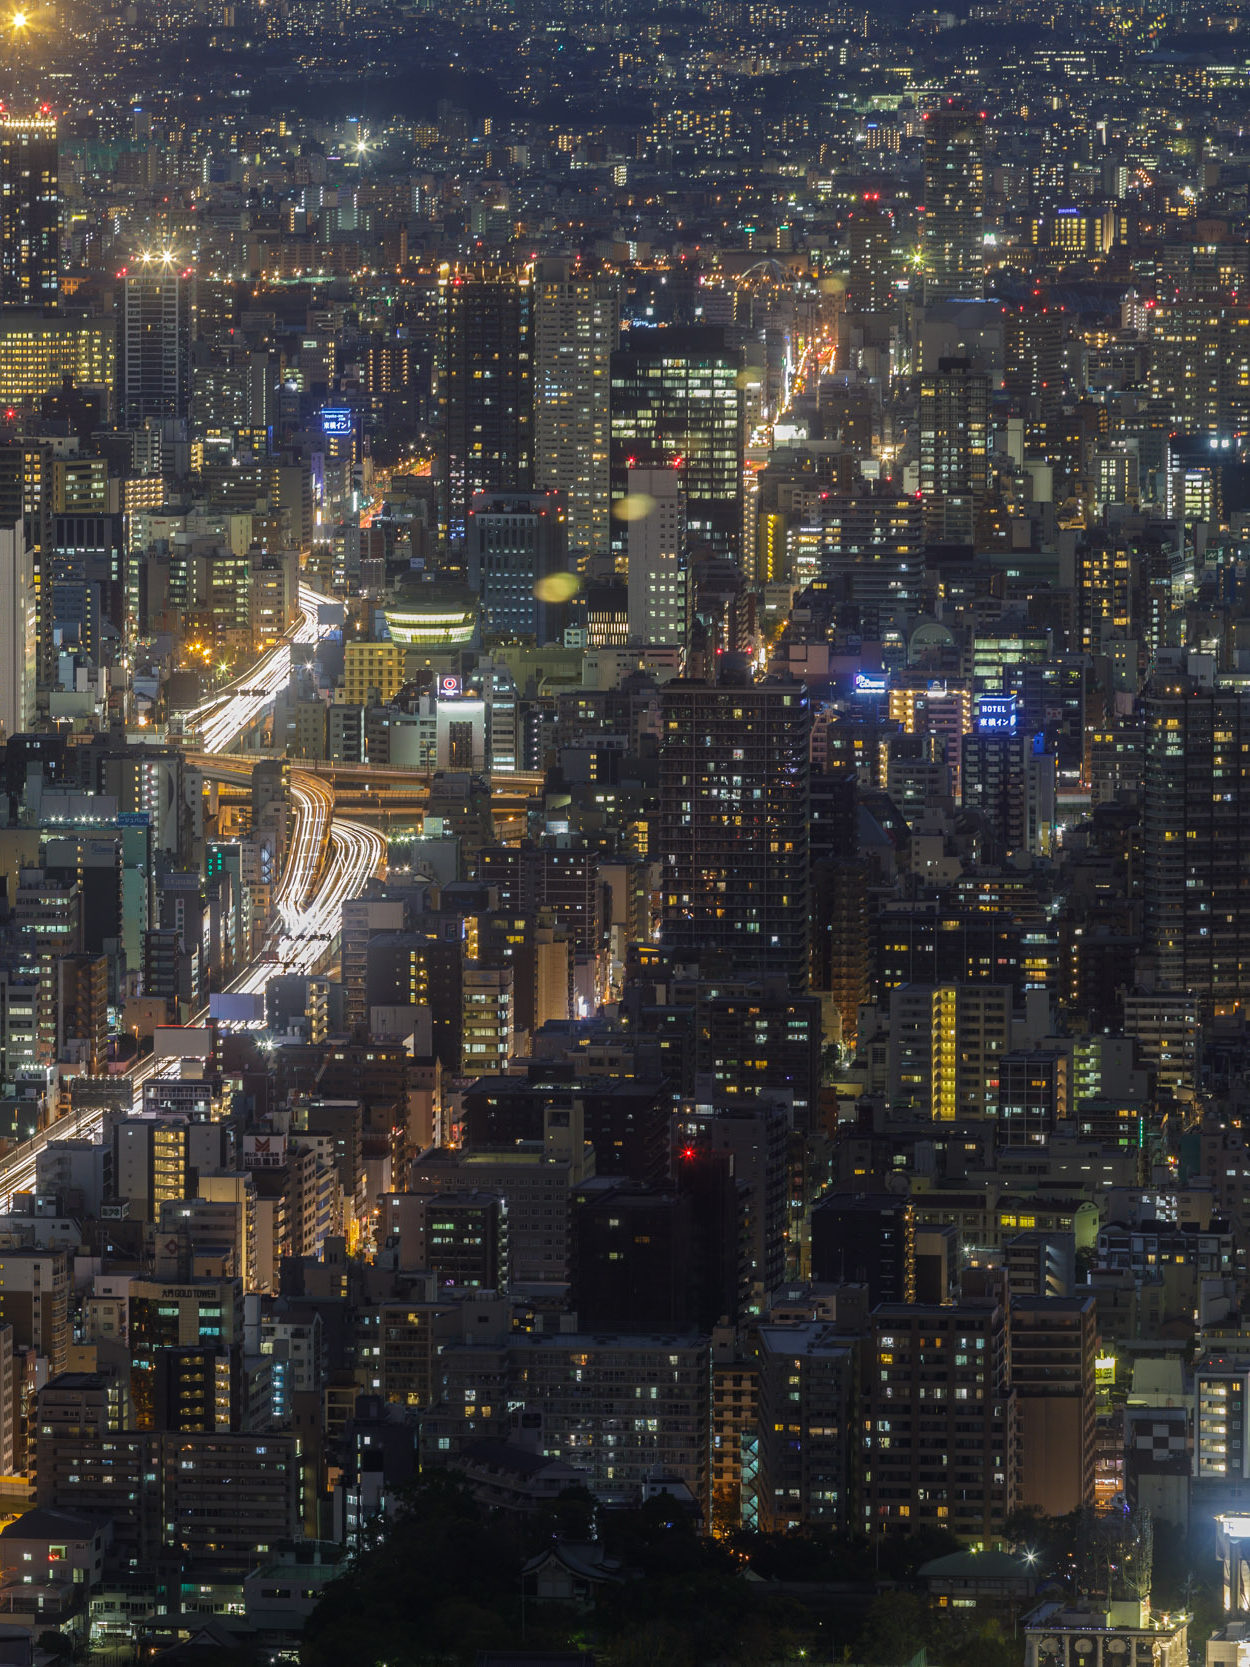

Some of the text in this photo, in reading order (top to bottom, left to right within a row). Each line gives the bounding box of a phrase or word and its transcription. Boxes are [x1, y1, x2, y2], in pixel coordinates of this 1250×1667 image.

[982, 705, 1007, 713] HOTEL
[979, 717, 1009, 727] 東横イン
[174, 1289, 193, 1298] GOLD
[193, 1289, 217, 1298] TOWER
